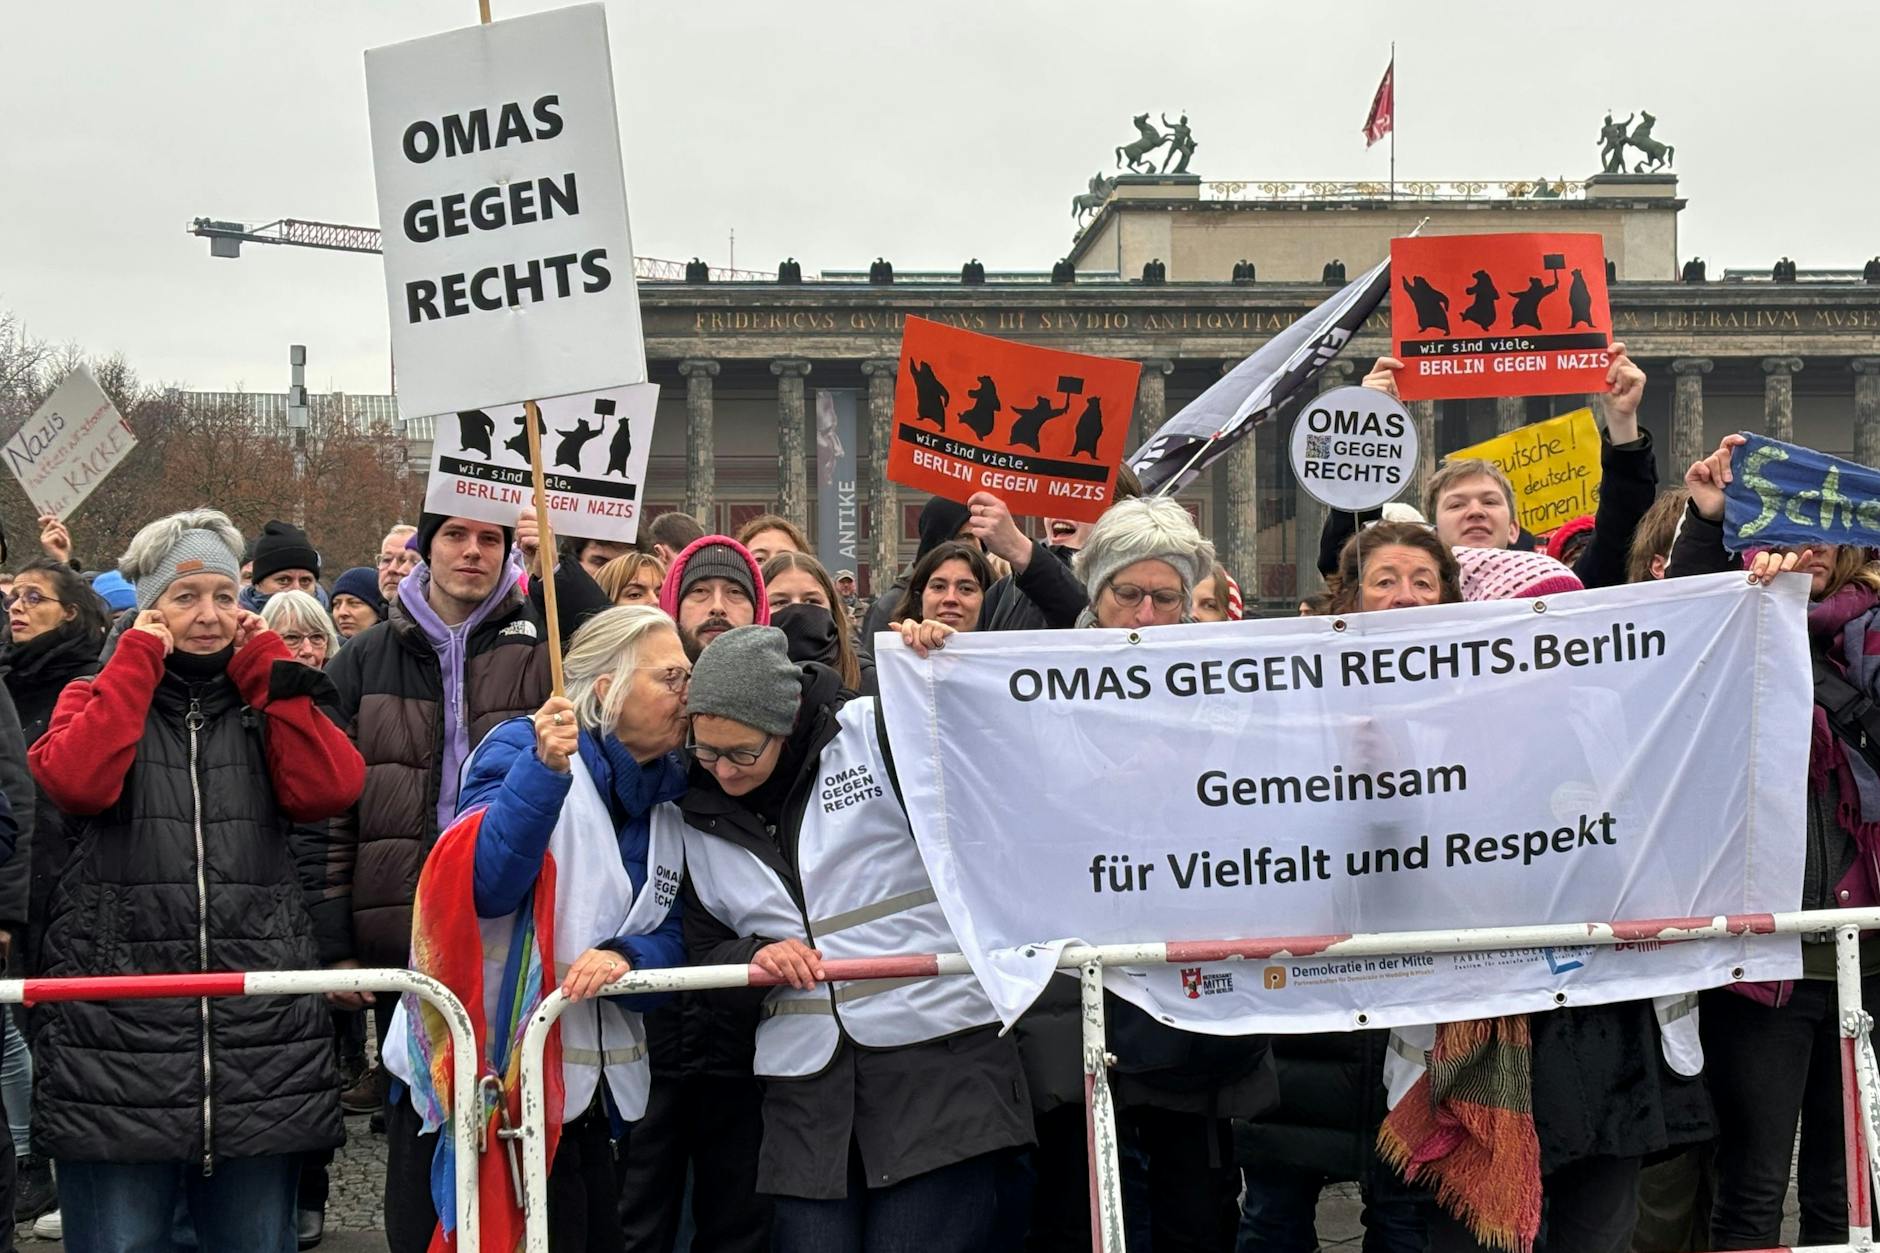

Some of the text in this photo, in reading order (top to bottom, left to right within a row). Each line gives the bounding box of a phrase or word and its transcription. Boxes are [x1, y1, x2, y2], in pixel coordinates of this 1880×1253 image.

[403, 95, 564, 163] OMAS
[403, 173, 579, 243] GEGEN
[405, 248, 612, 324] RECHTS
[696, 312, 834, 329] FRIDERICVS
[1000, 313, 1024, 329] III
[1039, 312, 1129, 329] STVDIO
[1653, 311, 1799, 328] LIBERALIVM
[1420, 338, 1535, 354] wir sind viele.
[1420, 353, 1610, 376] BERLIN GEGEN NAZIS
[1308, 408, 1405, 438] OMAS
[6, 412, 65, 478] Nazis
[916, 432, 1029, 471] wir sind viele.
[1334, 441, 1402, 459] GEGEN
[459, 463, 483, 476] wir
[491, 469, 523, 484] sind
[913, 450, 1105, 501] BERLIN GEGEN NAZIS
[1304, 461, 1401, 484] RECHTS
[1524, 462, 1591, 495] deutsche
[456, 480, 522, 505] BERLIN
[587, 500, 633, 518] NAZIS
[839, 481, 856, 559] ANTIKE
[1009, 665, 1151, 702] OMAS
[1165, 654, 1323, 697] GEGEN
[822, 774, 874, 800] GEGEN
[825, 765, 867, 786] OMAS
[1197, 764, 1467, 807] Gemeinsam
[824, 786, 883, 813] RECHTS
[1089, 812, 1617, 892] für Vielfalt und Respekt
[1292, 955, 1433, 977] Demokratie in der Mitte
[1204, 978, 1232, 989] MITTE
